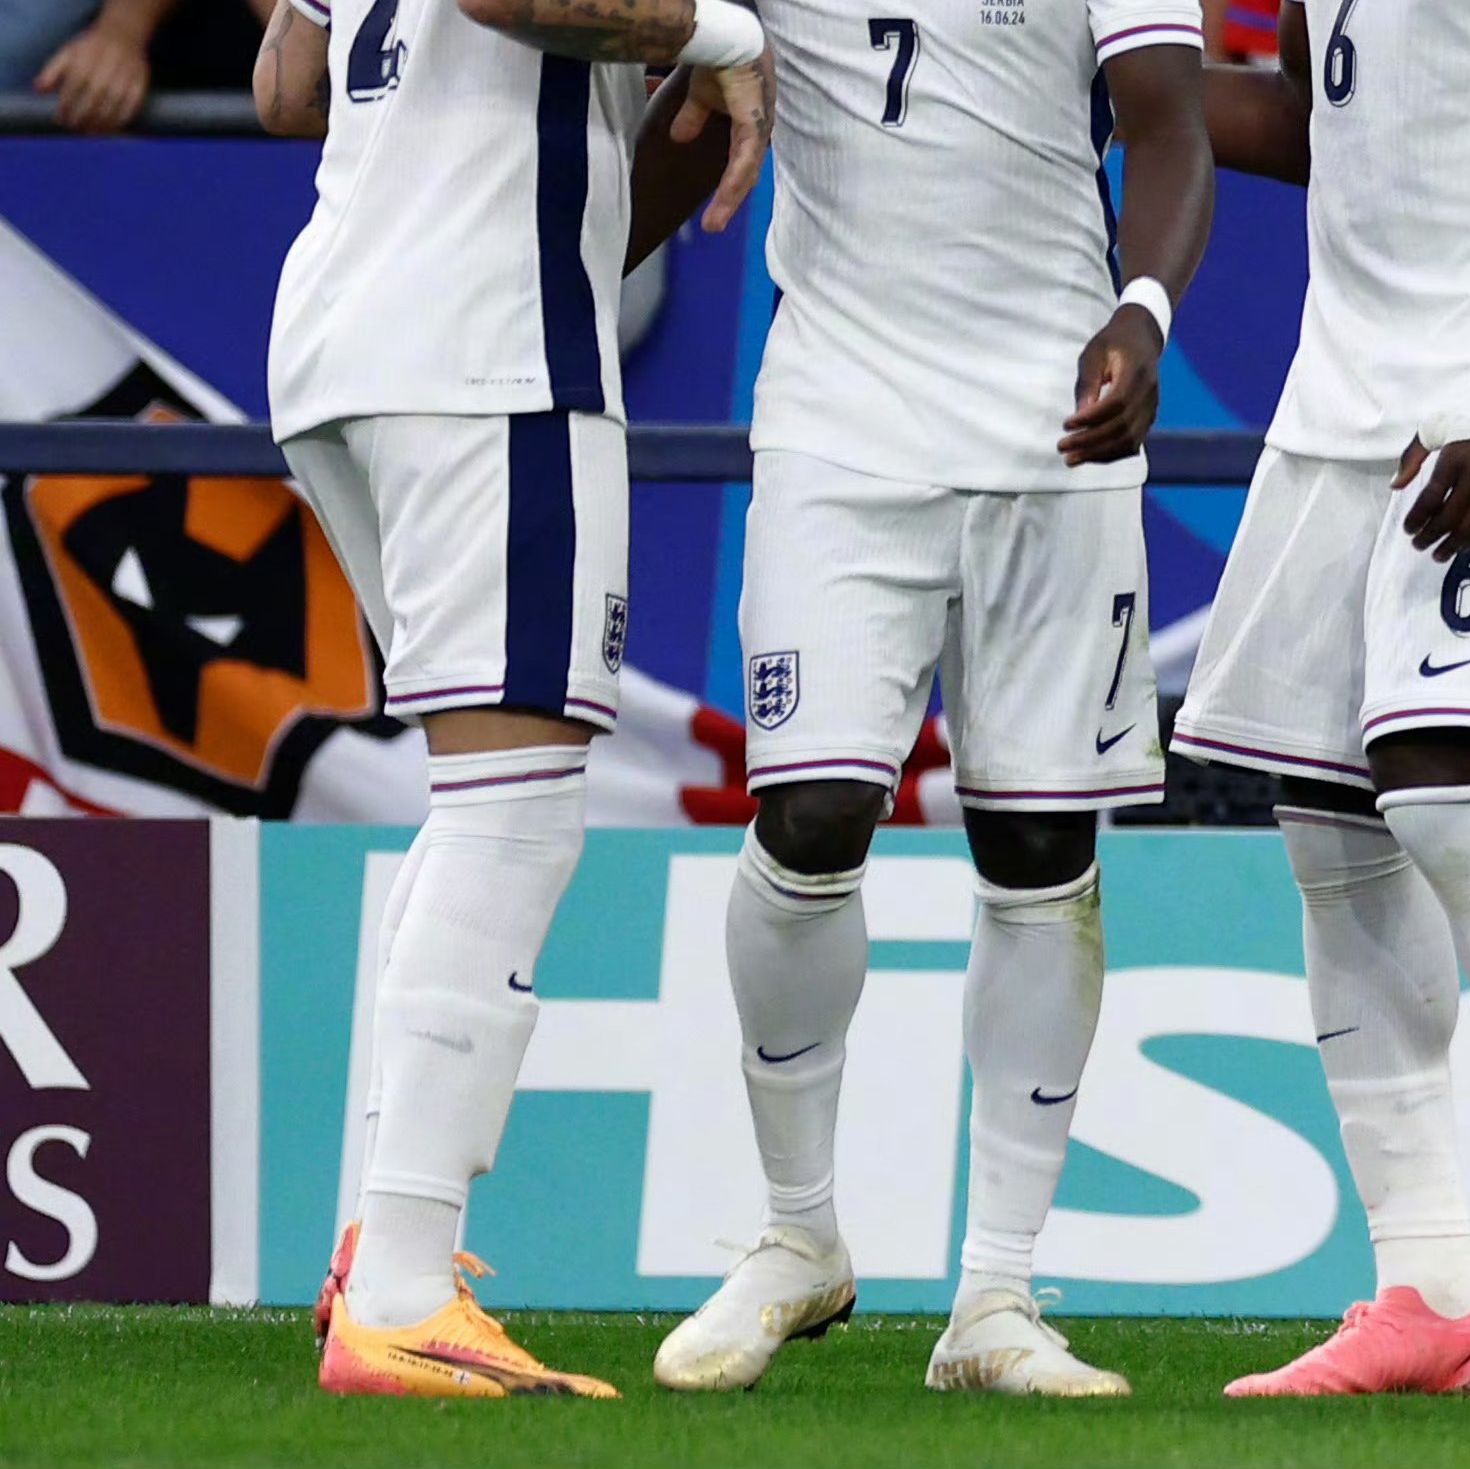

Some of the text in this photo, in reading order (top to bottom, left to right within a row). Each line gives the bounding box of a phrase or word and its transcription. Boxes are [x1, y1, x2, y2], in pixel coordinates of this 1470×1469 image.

[868, 17, 921, 128] 7
[979, 10, 1026, 26] 16.06.24
[1104, 591, 1136, 711] 7
[4, 1123, 98, 1281] S
